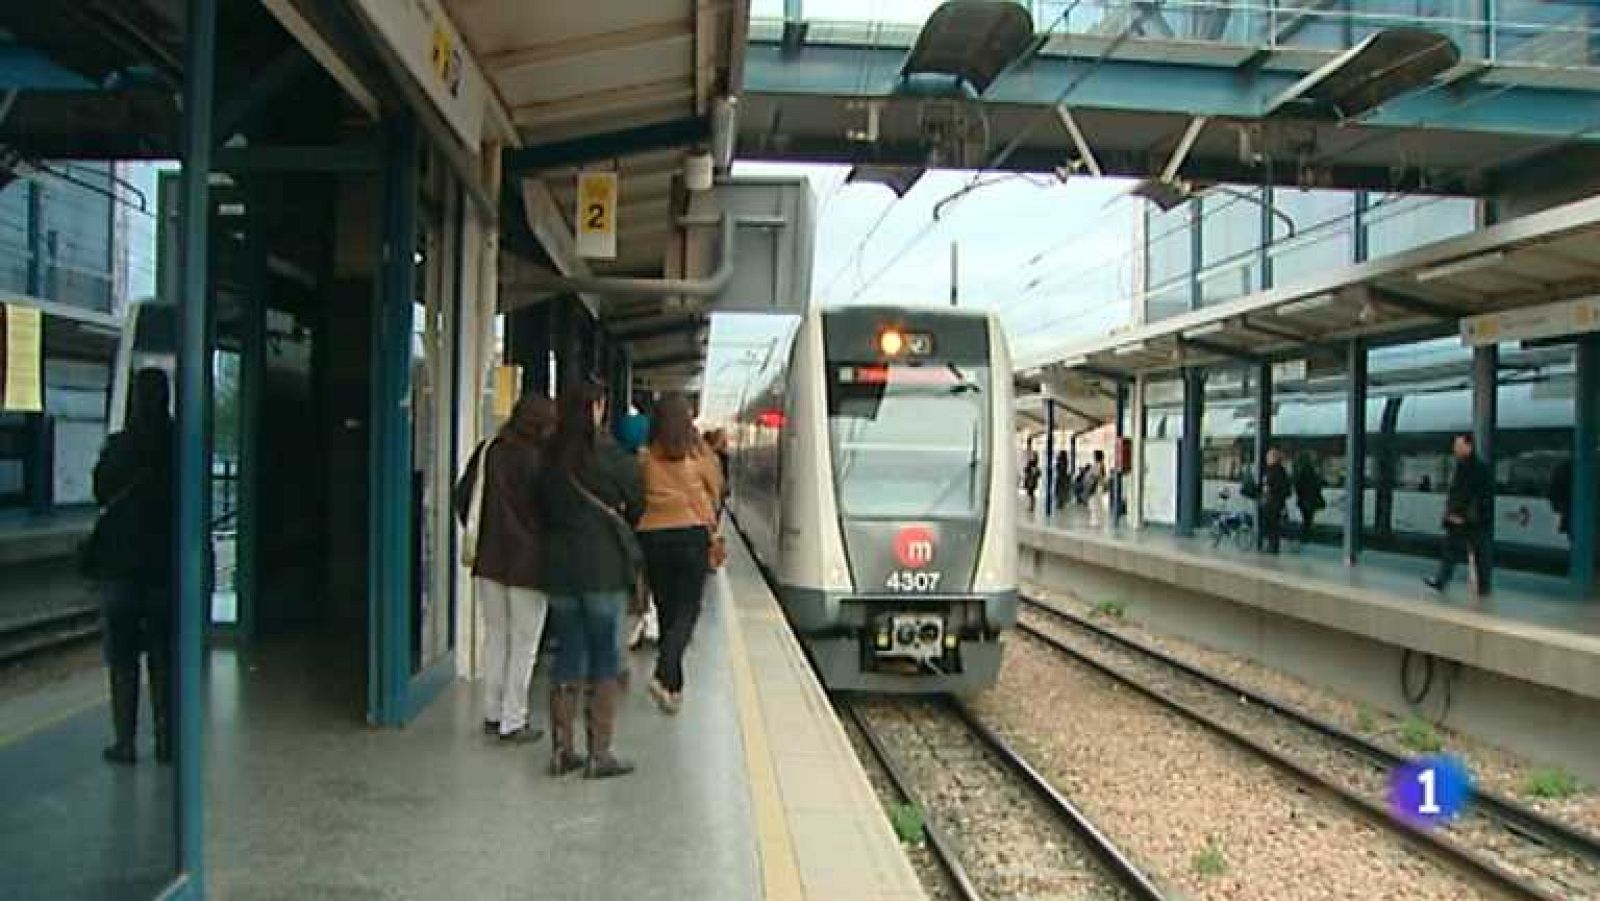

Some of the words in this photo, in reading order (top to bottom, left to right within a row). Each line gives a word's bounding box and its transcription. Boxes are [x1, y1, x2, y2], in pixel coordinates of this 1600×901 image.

[588, 203, 604, 229] 2
[908, 540, 932, 562] m
[886, 571, 940, 592] 4307
